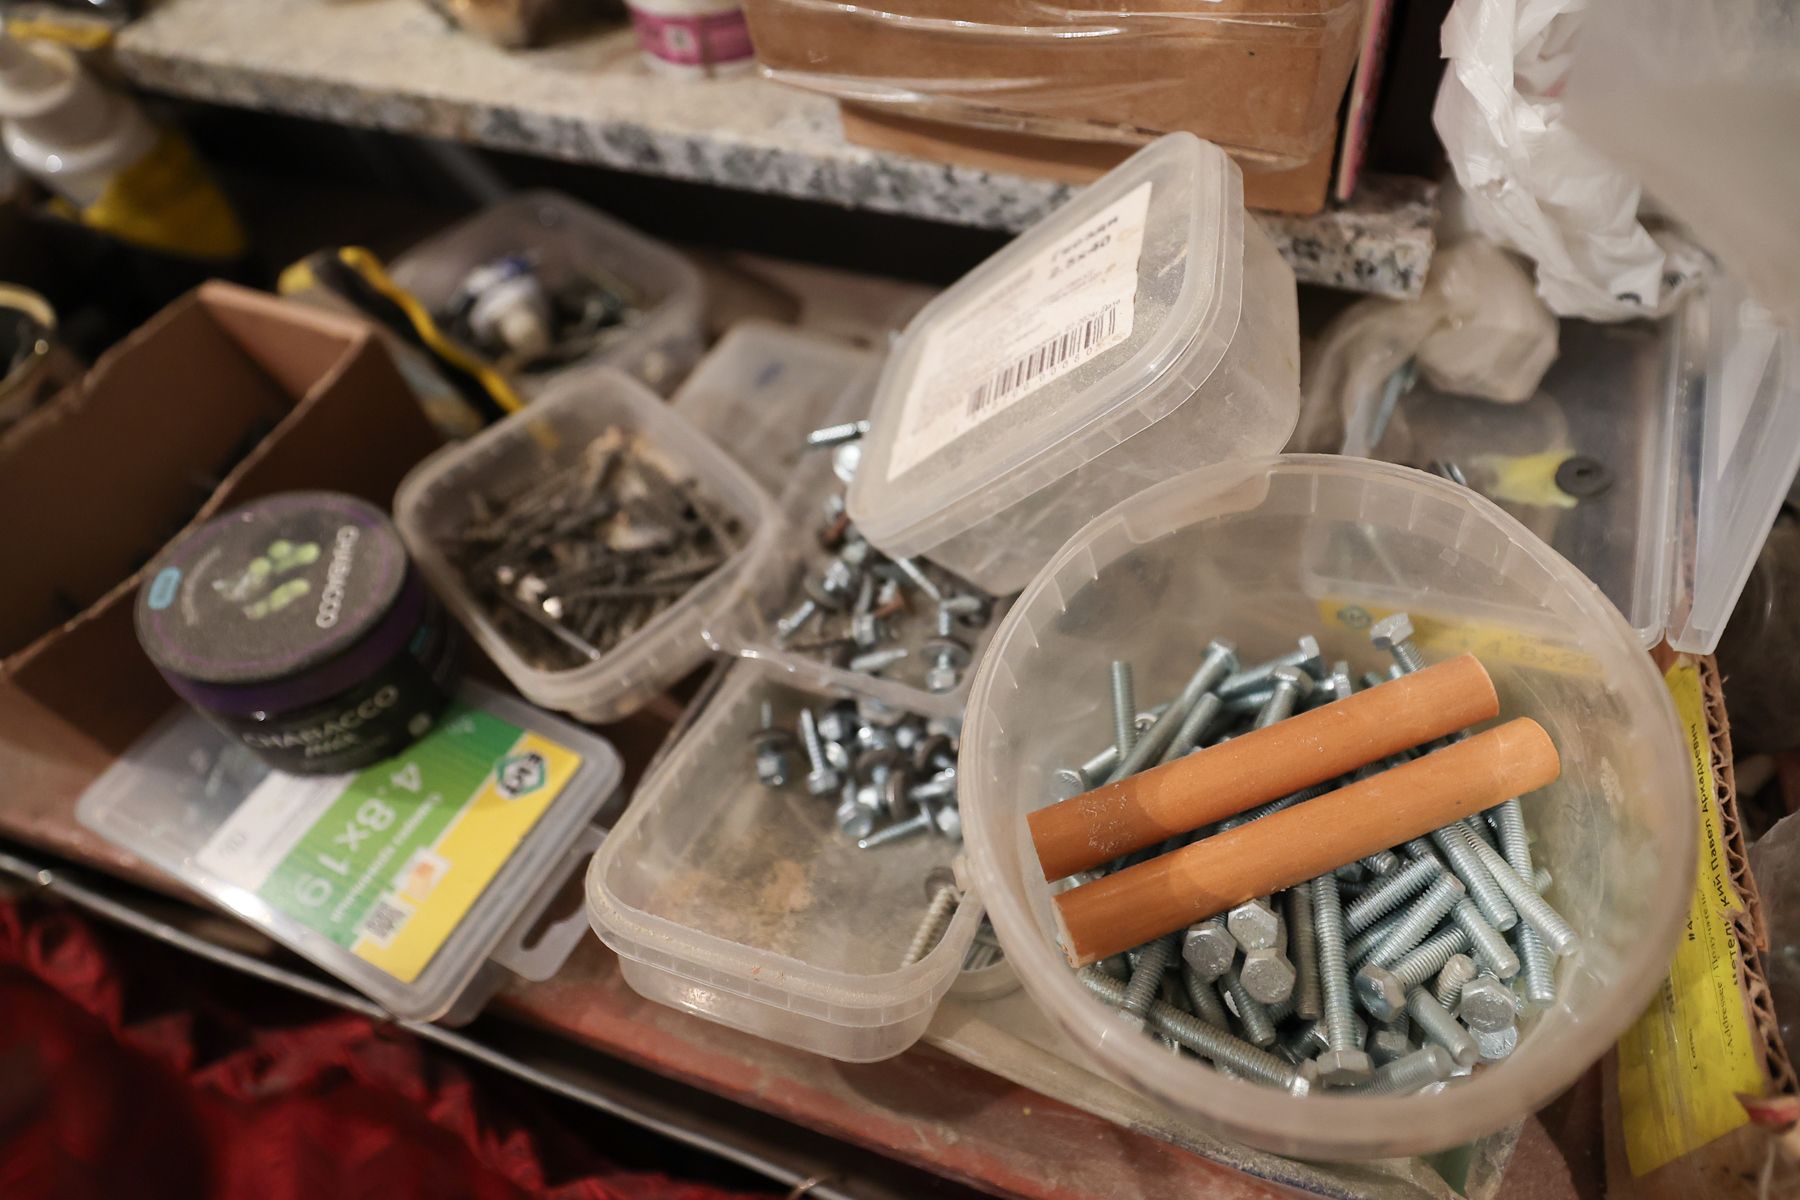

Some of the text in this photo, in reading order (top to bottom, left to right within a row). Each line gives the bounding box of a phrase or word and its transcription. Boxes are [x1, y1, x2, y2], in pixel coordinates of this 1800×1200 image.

[242, 686, 398, 749] CHABACCO
[1691, 722, 1709, 813] Аркадьевич
[1705, 817, 1720, 872] Павел
